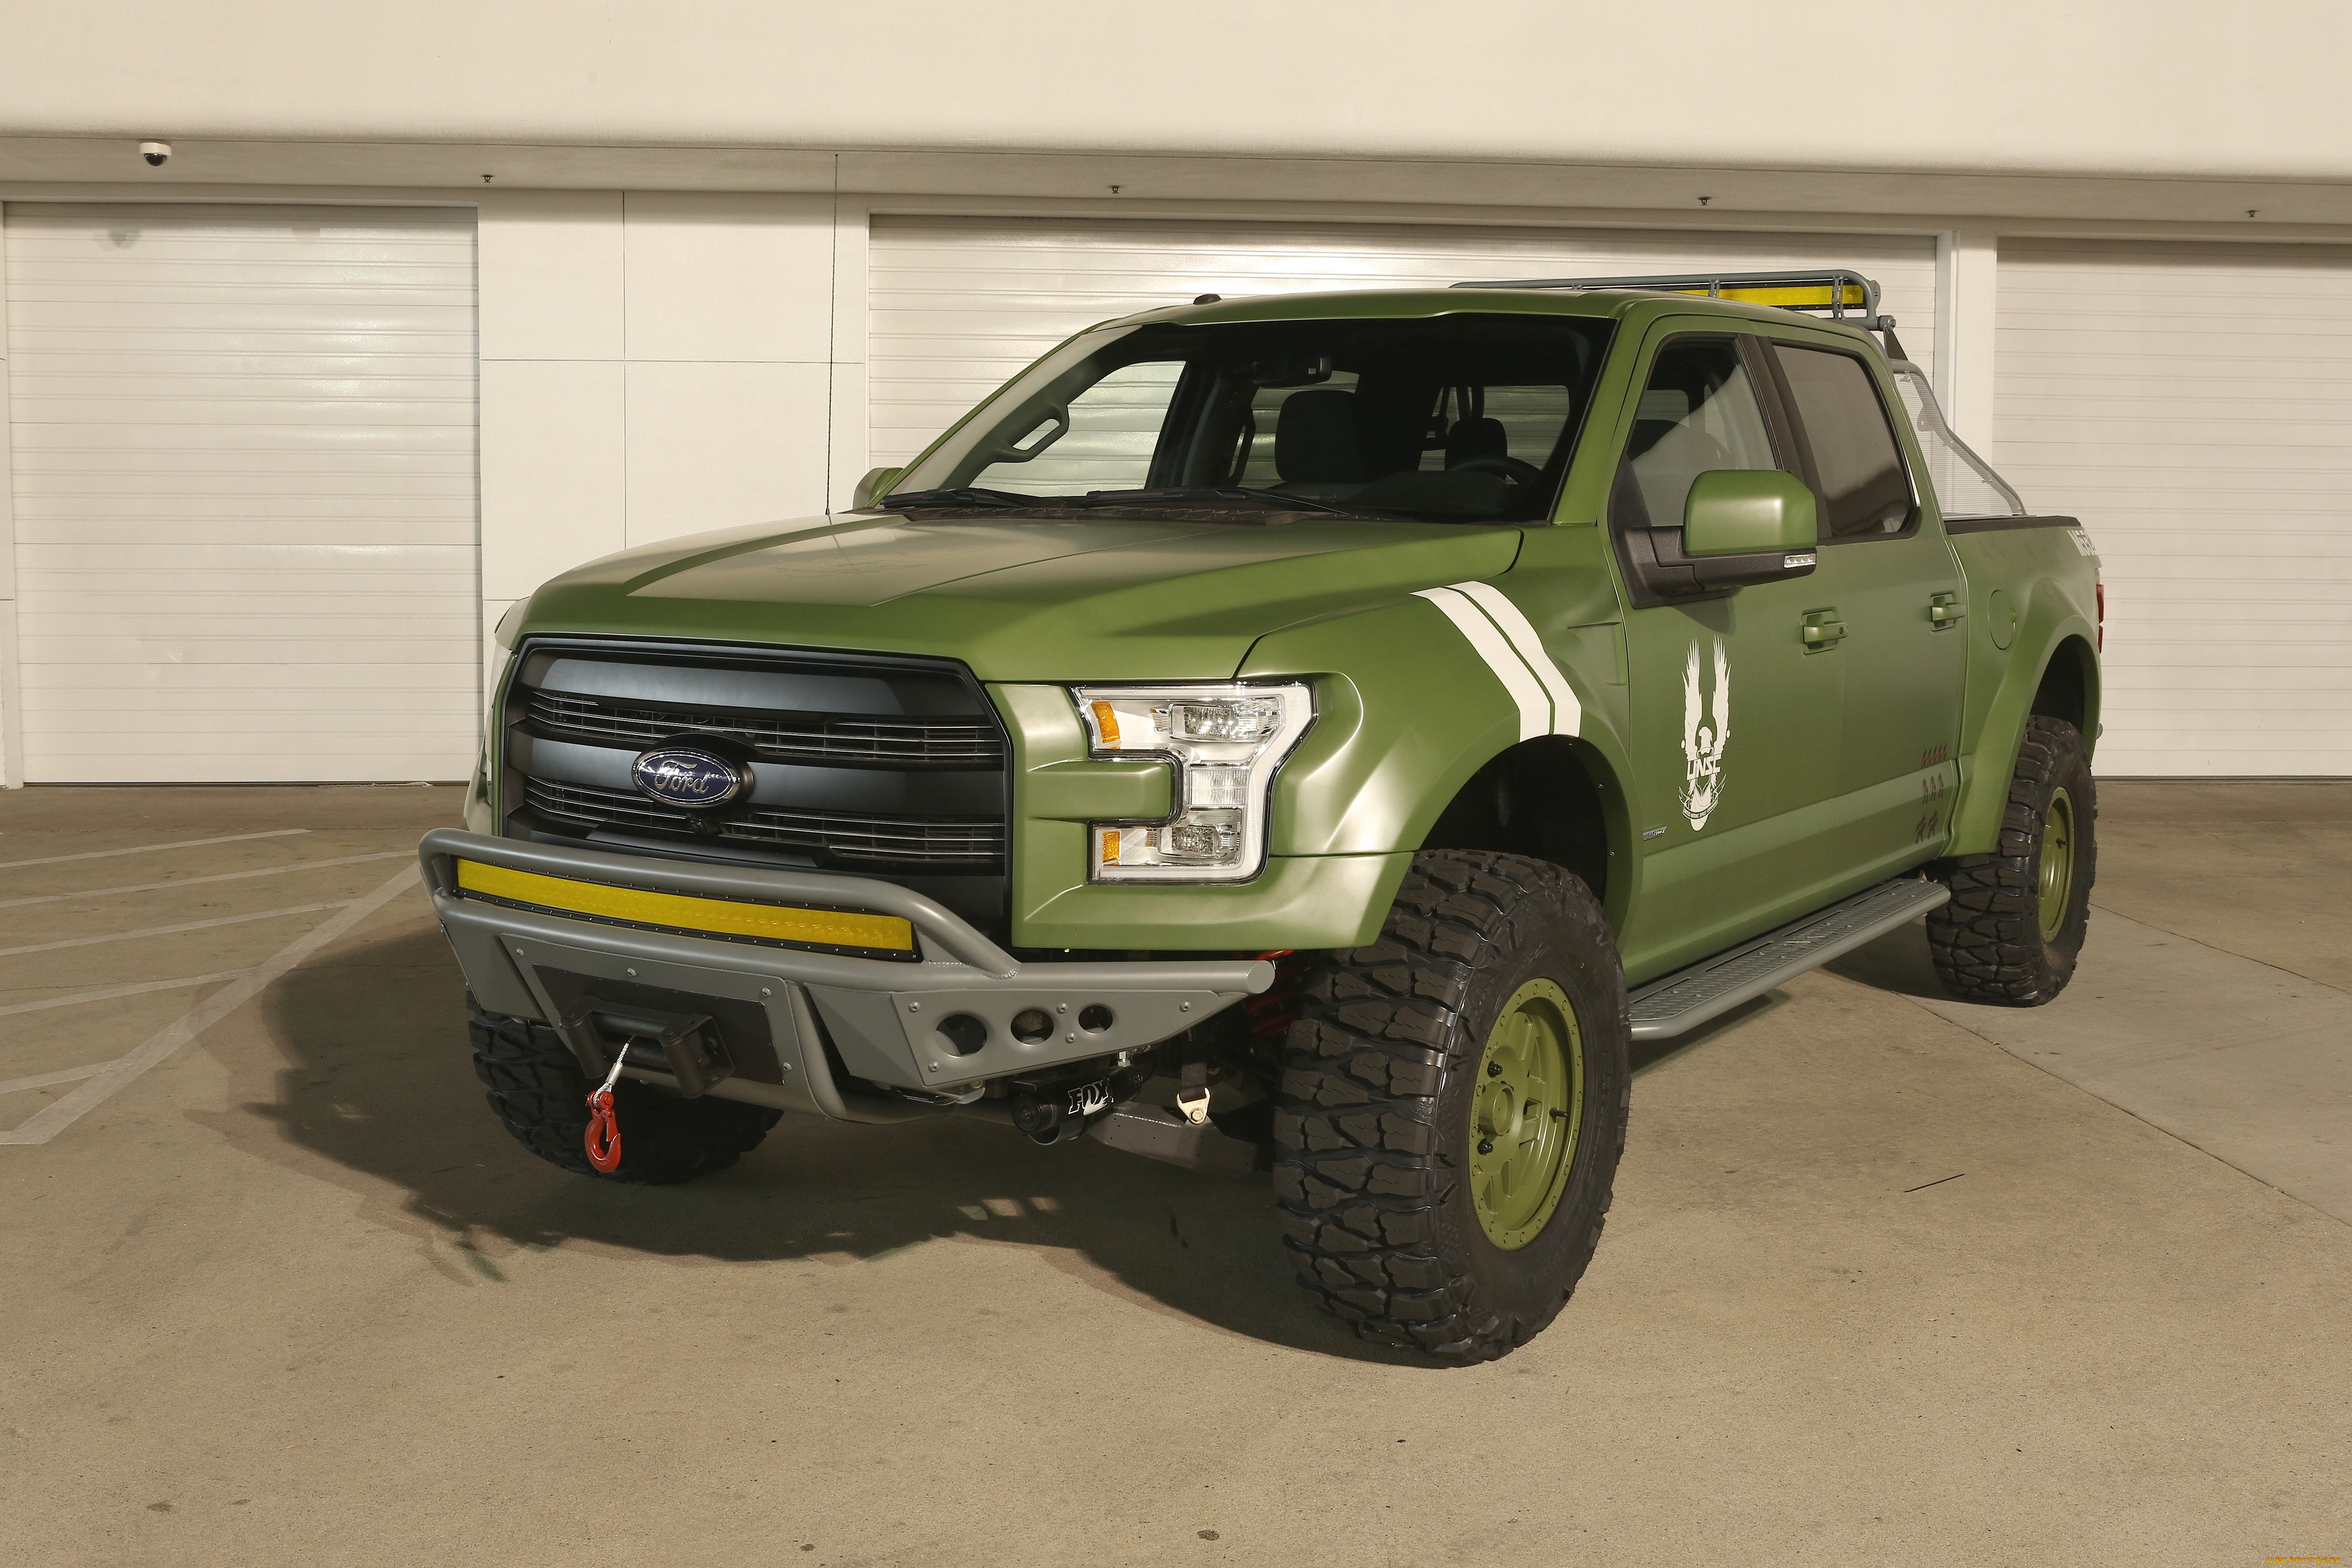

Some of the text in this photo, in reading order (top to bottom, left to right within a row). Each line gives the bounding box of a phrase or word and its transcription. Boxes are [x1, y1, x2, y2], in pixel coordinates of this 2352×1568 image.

[654, 759, 709, 793] Ford
[1687, 754, 1722, 780] UNSC
[1068, 1079, 1109, 1115] FOX
